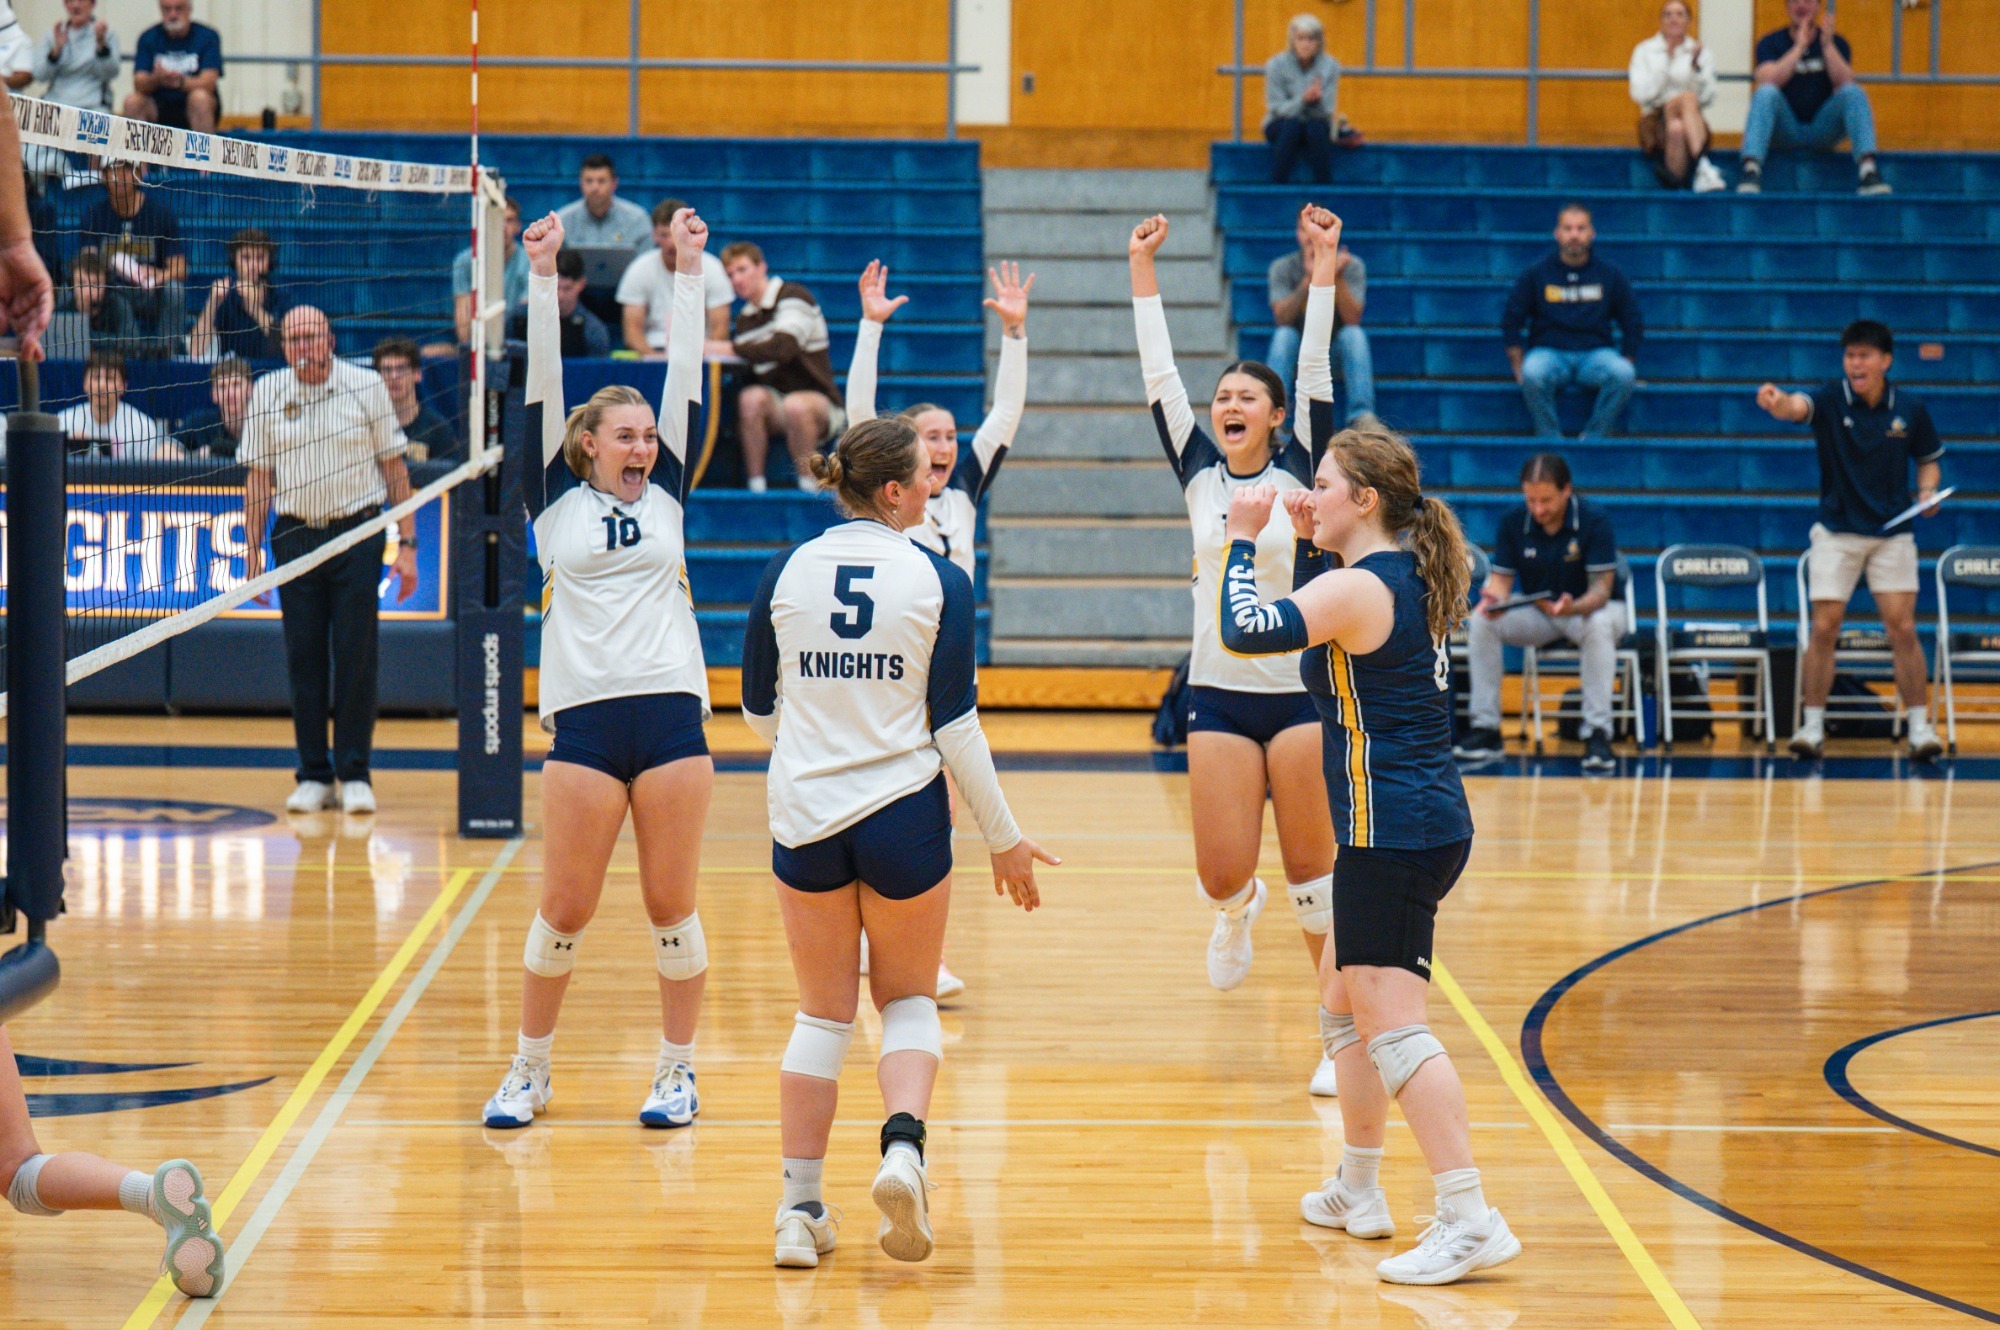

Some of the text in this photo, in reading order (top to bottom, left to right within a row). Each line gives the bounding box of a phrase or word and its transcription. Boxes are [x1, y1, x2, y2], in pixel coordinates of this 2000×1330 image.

[0, 510, 265, 592] GHTS
[602, 516, 641, 551] 10
[1672, 558, 1749, 576] CARLETON
[1954, 559, 2000, 577] CARLE
[830, 565, 875, 639] 5
[799, 651, 904, 680] KNIGHTS
[482, 633, 501, 755] sports imports
